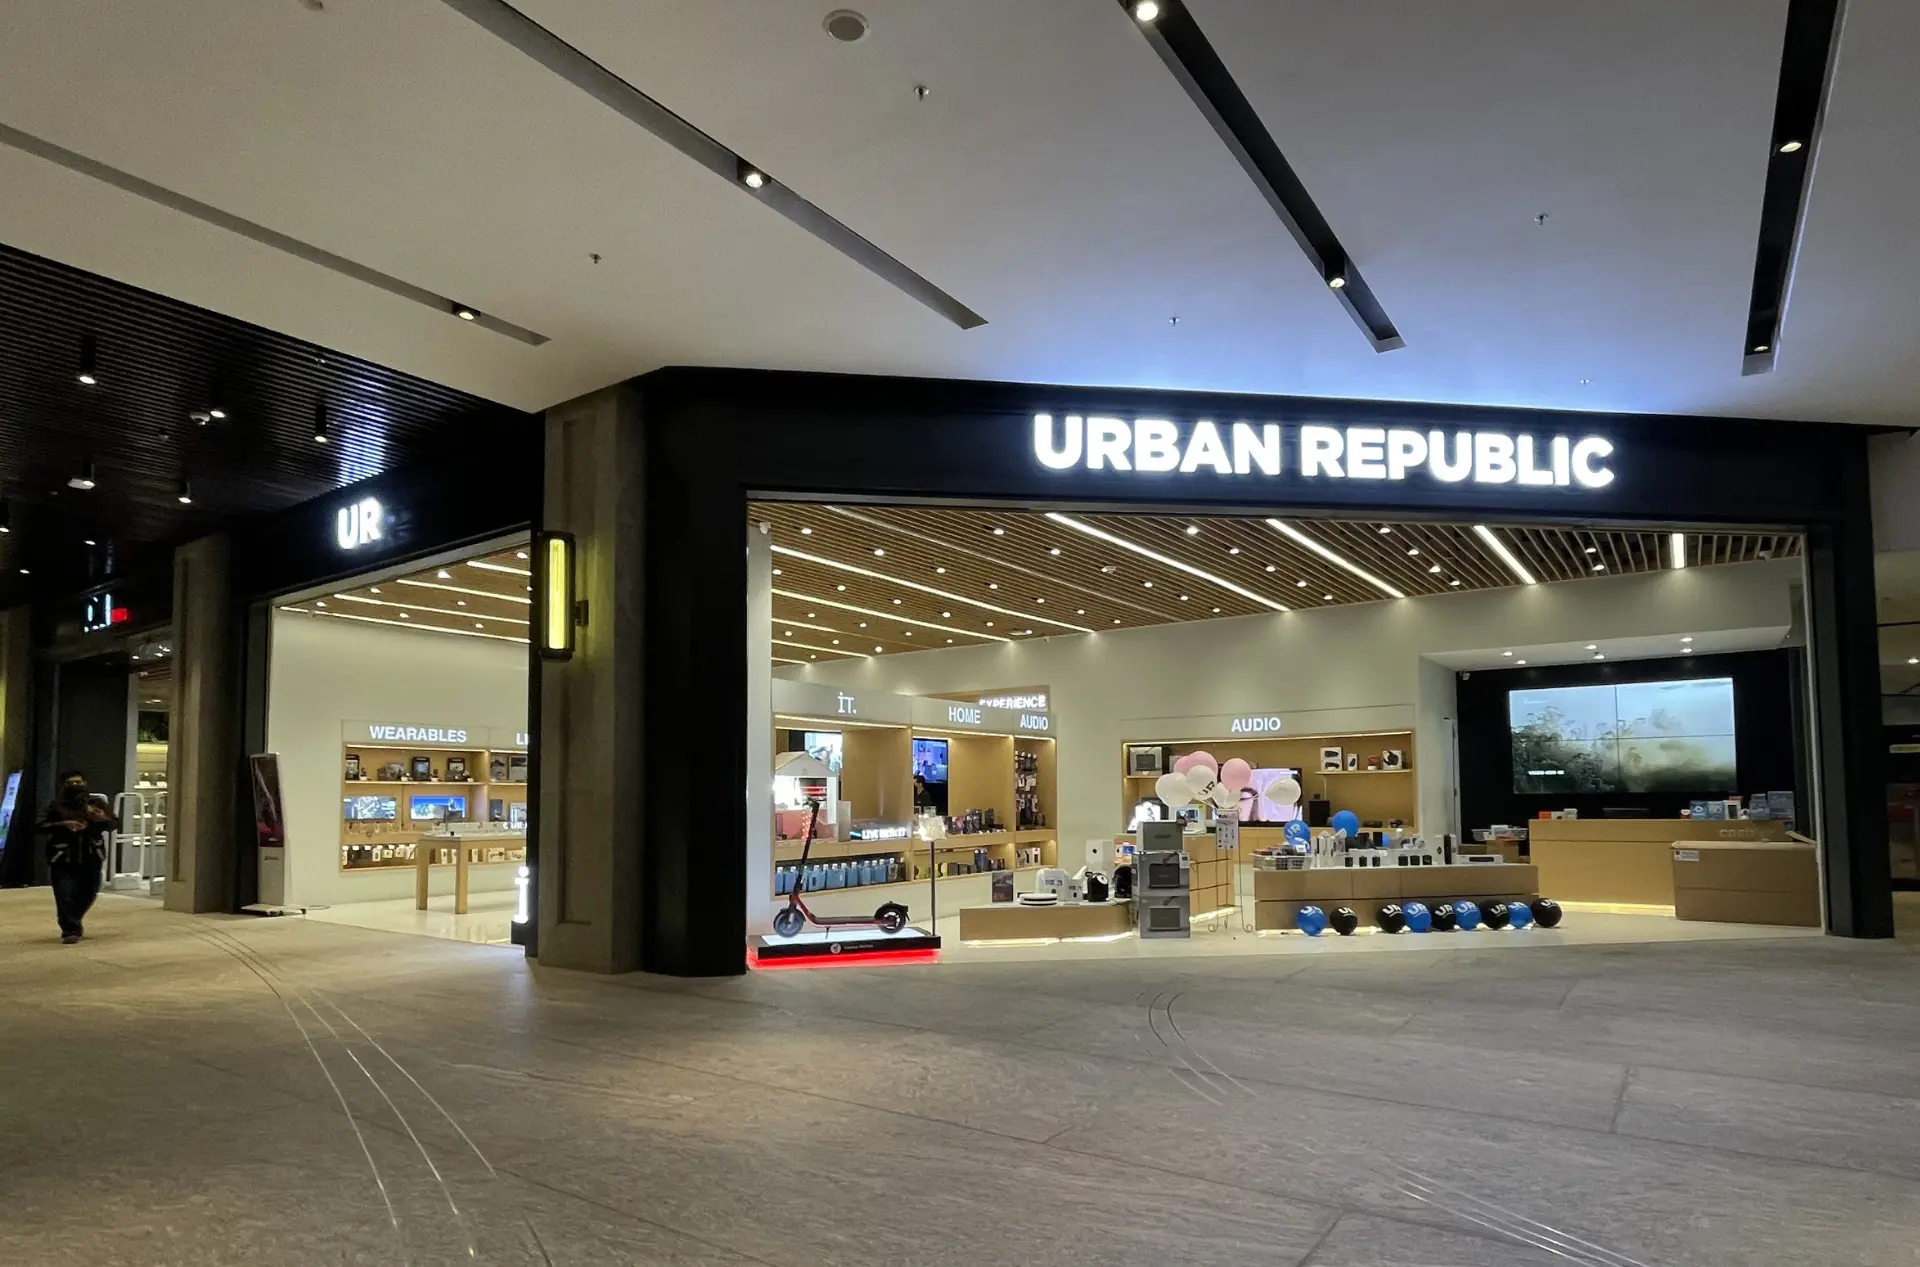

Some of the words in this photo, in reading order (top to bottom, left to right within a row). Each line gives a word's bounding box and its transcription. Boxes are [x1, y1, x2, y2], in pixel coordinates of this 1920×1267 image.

[1033, 413, 1281, 476] URBAN
[1301, 425, 1615, 488] REPUBLIC
[337, 496, 382, 550] UR
[948, 706, 981, 724] HOME
[1020, 714, 1049, 731] AUDIO
[1231, 717, 1281, 732] AUDIO
[369, 725, 467, 743] WEARABLES
[1407, 903, 1429, 916] UR
[1434, 904, 1453, 917] UR
[1456, 901, 1477, 914] UR
[1490, 904, 1508, 915] UR
